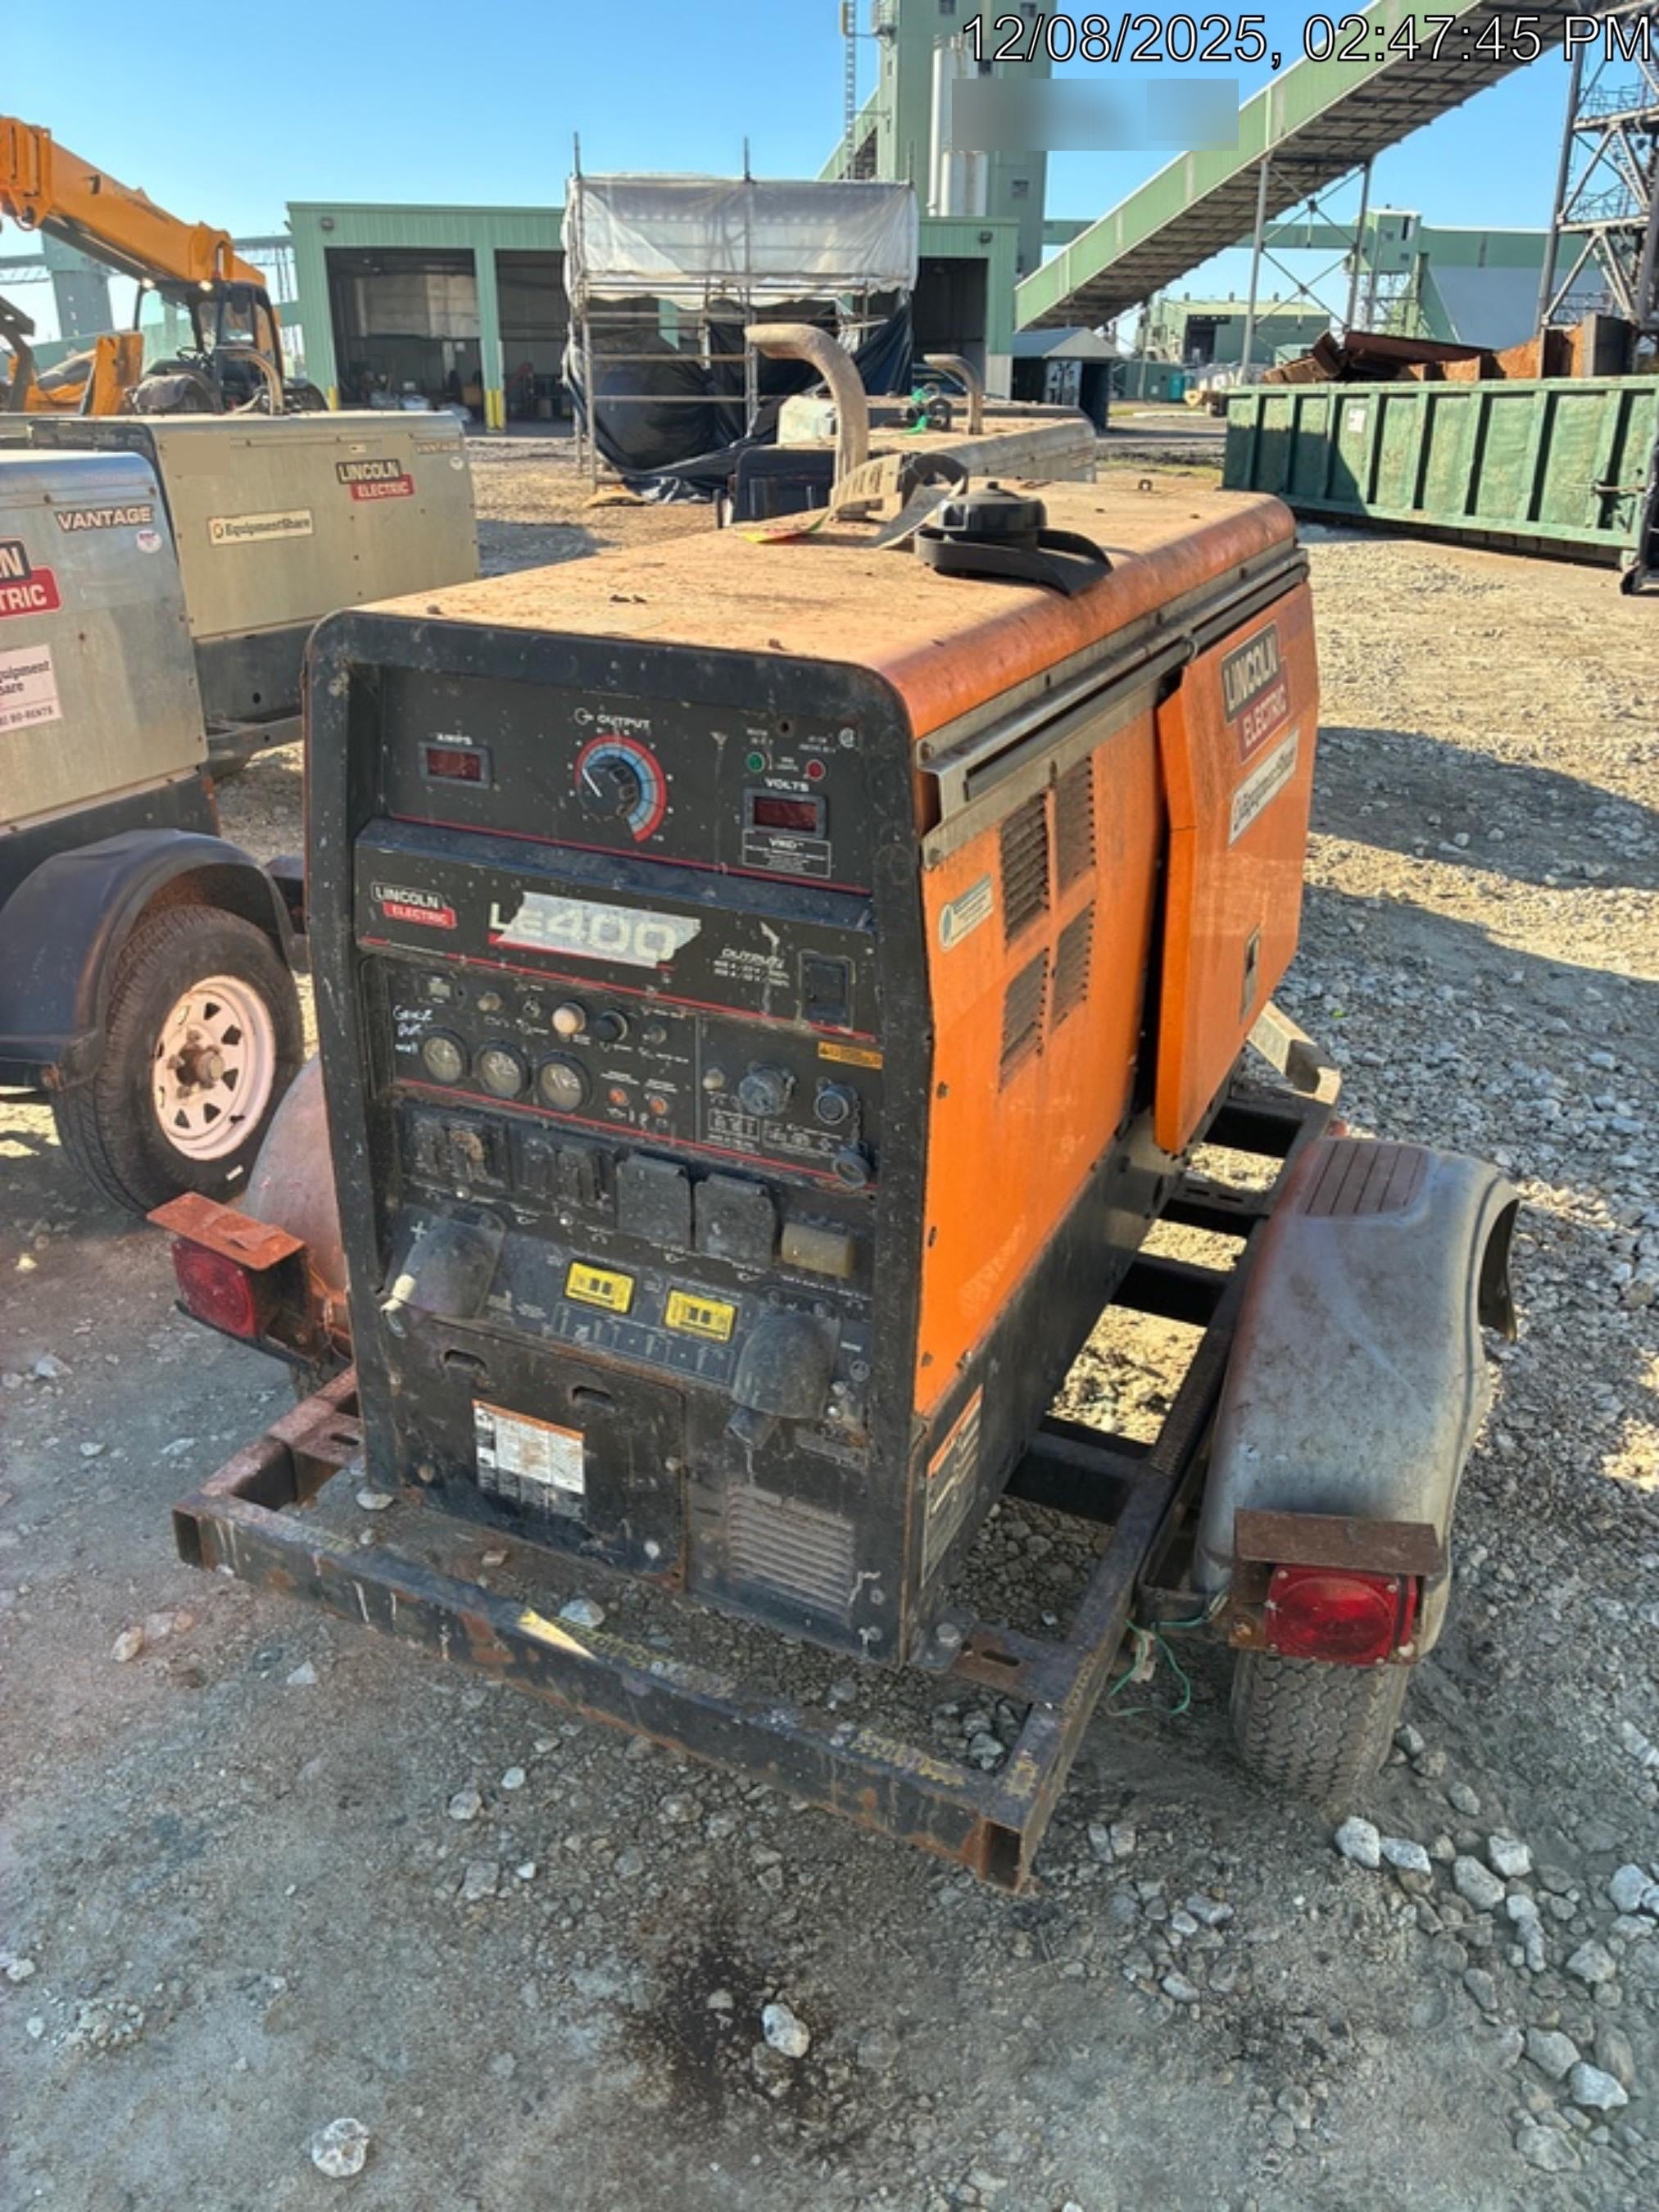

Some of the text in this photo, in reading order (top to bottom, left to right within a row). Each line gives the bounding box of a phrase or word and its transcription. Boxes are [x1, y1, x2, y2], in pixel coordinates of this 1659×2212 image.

[338, 460, 400, 481] LINCOLN
[356, 481, 410, 498] ELECTRIC
[57, 505, 153, 531] VANTAGE
[1223, 632, 1279, 713] LINCOLN
[596, 714, 652, 729] OUTPUT
[1242, 683, 1287, 749] ELECTRIC
[764, 777, 809, 792] VOLTS
[374, 885, 438, 909] LINCOLN
[392, 905, 447, 926] ELECTRIC
